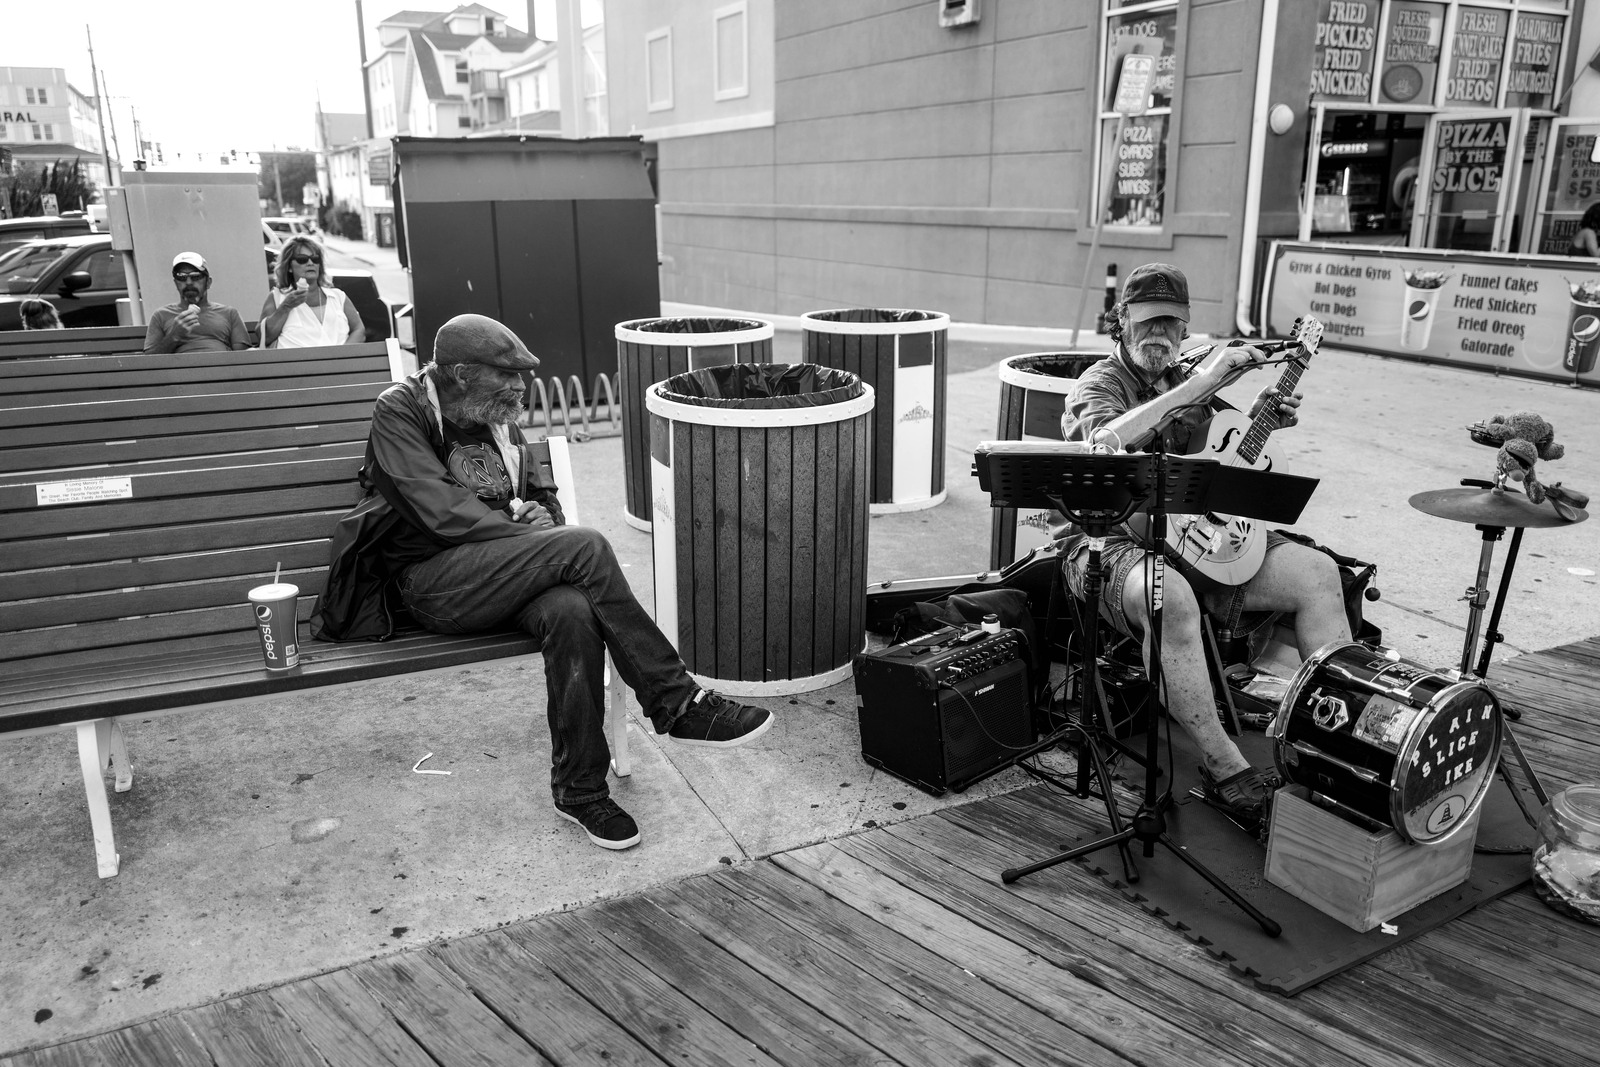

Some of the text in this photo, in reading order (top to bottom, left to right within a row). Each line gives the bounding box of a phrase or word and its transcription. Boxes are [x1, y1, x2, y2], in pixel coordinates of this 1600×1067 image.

[1328, 1, 1367, 24] FRIED
[1398, 10, 1430, 26] FRESH
[1461, 12, 1498, 33] FRESH
[1315, 22, 1374, 50] PICKLES
[1516, 17, 1563, 43] OARDWALK
[1386, 43, 1436, 63] LEMONADE
[1453, 33, 1504, 59] UNNEL CAKES
[1515, 42, 1552, 66] FRIES
[1323, 48, 1362, 70] FRIED
[1456, 59, 1490, 79] FRIED
[1310, 70, 1371, 96] SNICKERS
[1446, 78, 1494, 101] OREOS
[1508, 70, 1555, 94] AMBURGERS
[0, 112, 37, 123] RAL
[1124, 127, 1152, 142] PIZZA
[1438, 122, 1506, 148] PIZZA
[1566, 135, 1594, 148] SPE
[1119, 144, 1153, 160] GYROS
[1445, 149, 1493, 164] BY THE
[1119, 161, 1145, 177] SUBS
[1432, 165, 1500, 193] SLICE
[1118, 179, 1150, 195] WINGS
[1289, 261, 1392, 281] Gyros & Chicken Gyros
[1314, 281, 1357, 298] Hot Dogs
[1460, 273, 1539, 294] Funnel Cakes
[1310, 300, 1357, 317] Corn Dogs
[1453, 294, 1538, 316] Fried Snickers
[1457, 315, 1526, 338] Fried Oreos
[1460, 337, 1516, 357] Gatorade
[260, 623, 278, 660] pepsi
[1422, 730, 1479, 778] SLICE
